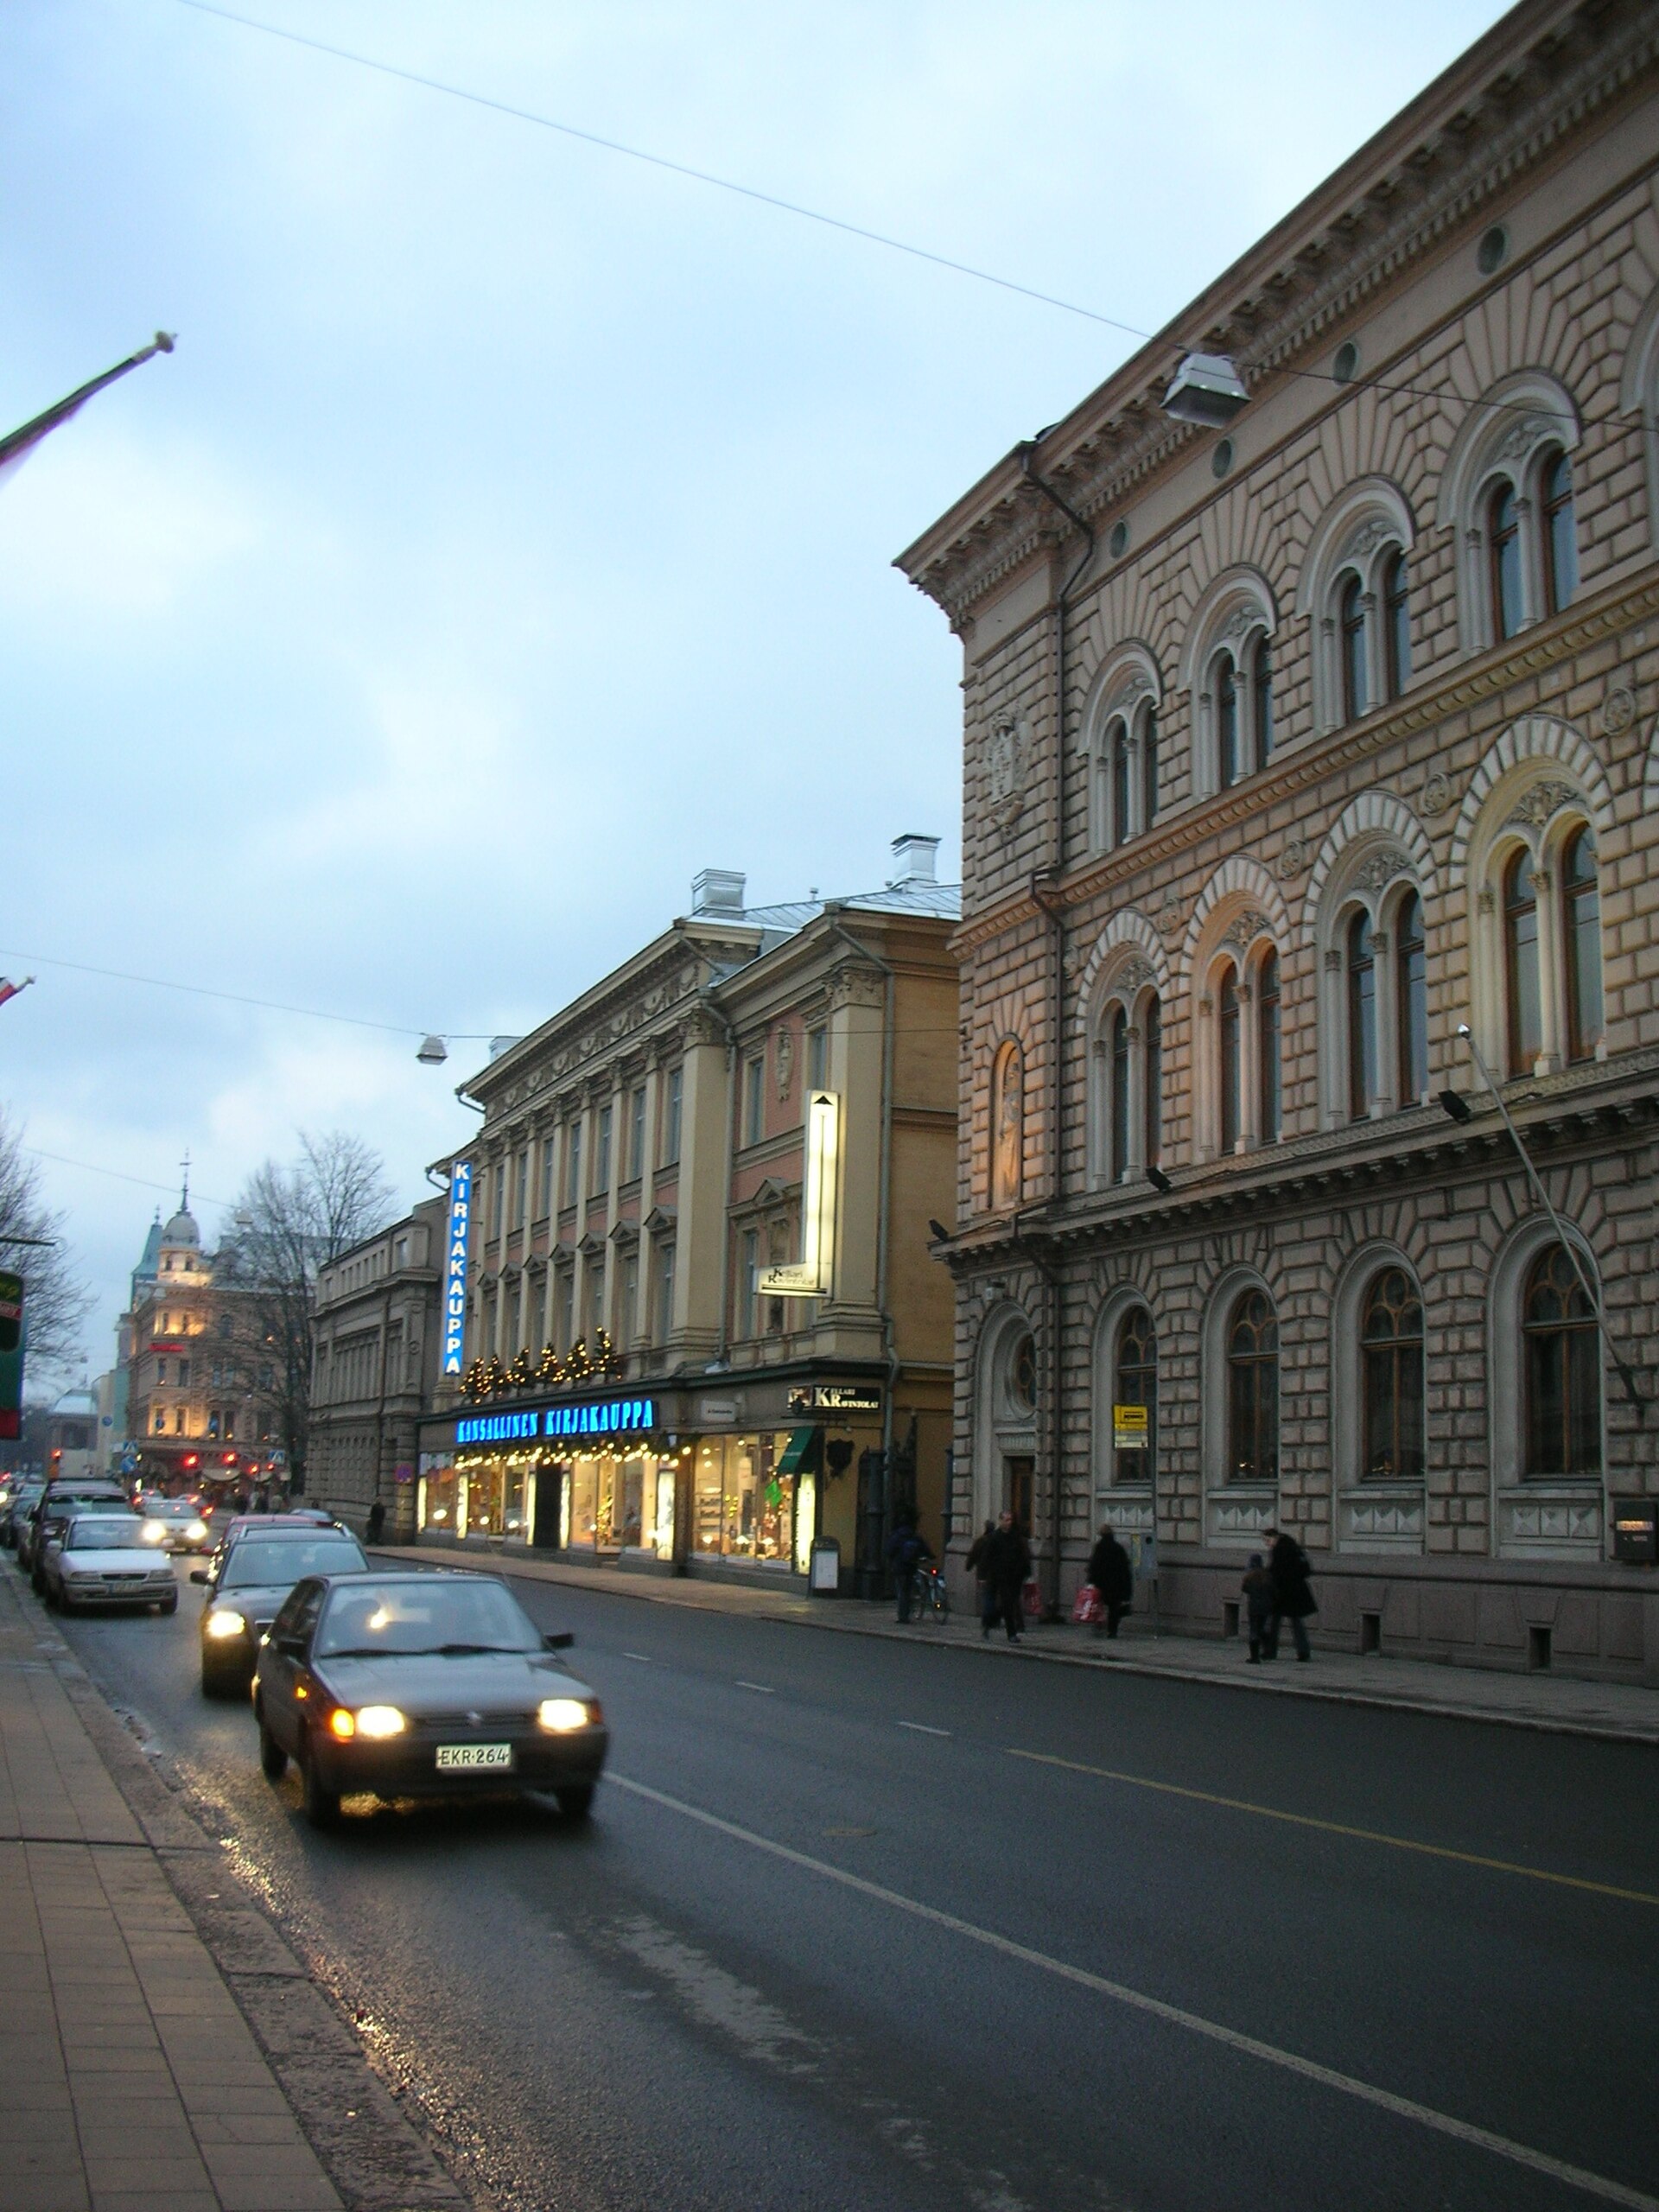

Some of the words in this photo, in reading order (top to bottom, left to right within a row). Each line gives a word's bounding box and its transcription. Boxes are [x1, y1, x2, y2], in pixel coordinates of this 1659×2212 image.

[445, 1164, 470, 1374] KIRJAKAUPPA
[456, 1413, 539, 1443] KANSALLINEN
[545, 1400, 654, 1436] KIRJAKAUPPA
[441, 1749, 506, 1764] EKR-264
